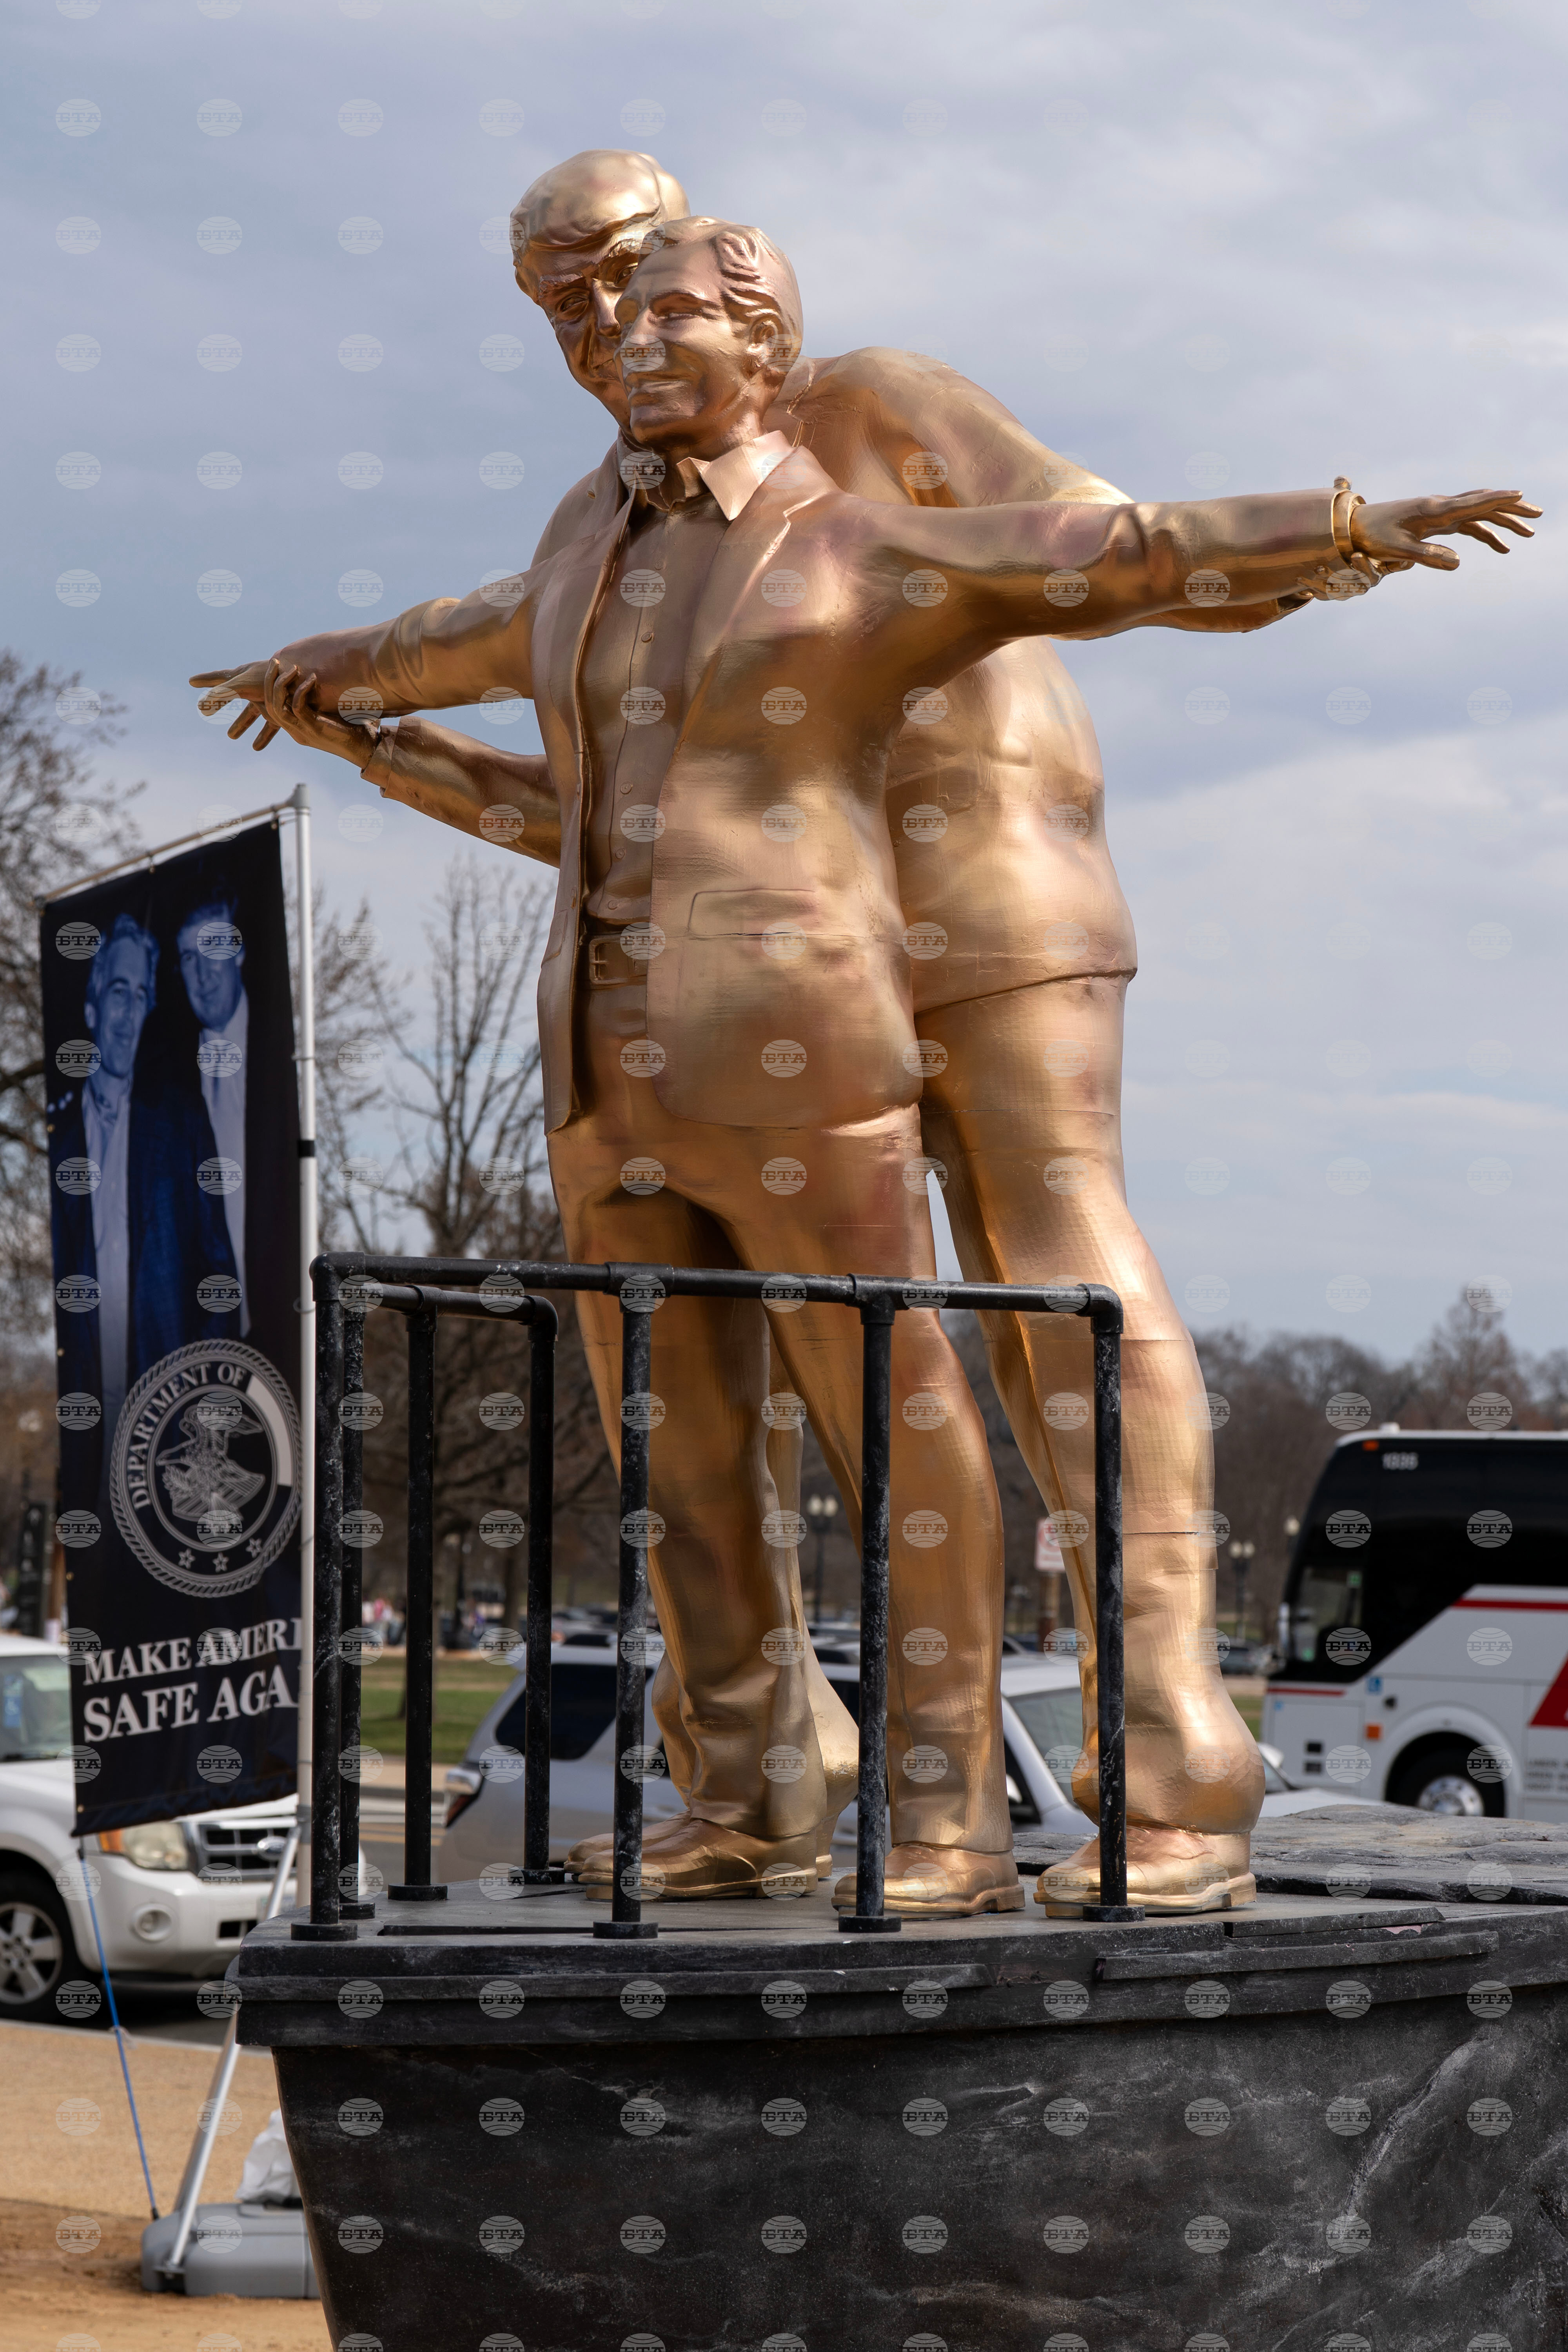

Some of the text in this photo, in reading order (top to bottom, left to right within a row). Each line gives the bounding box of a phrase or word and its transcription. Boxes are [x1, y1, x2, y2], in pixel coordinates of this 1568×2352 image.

[127, 1362, 247, 1510] DEPARTMENT OF
[83, 1637, 192, 1685] MAKE
[83, 1682, 200, 1743] SAFE
